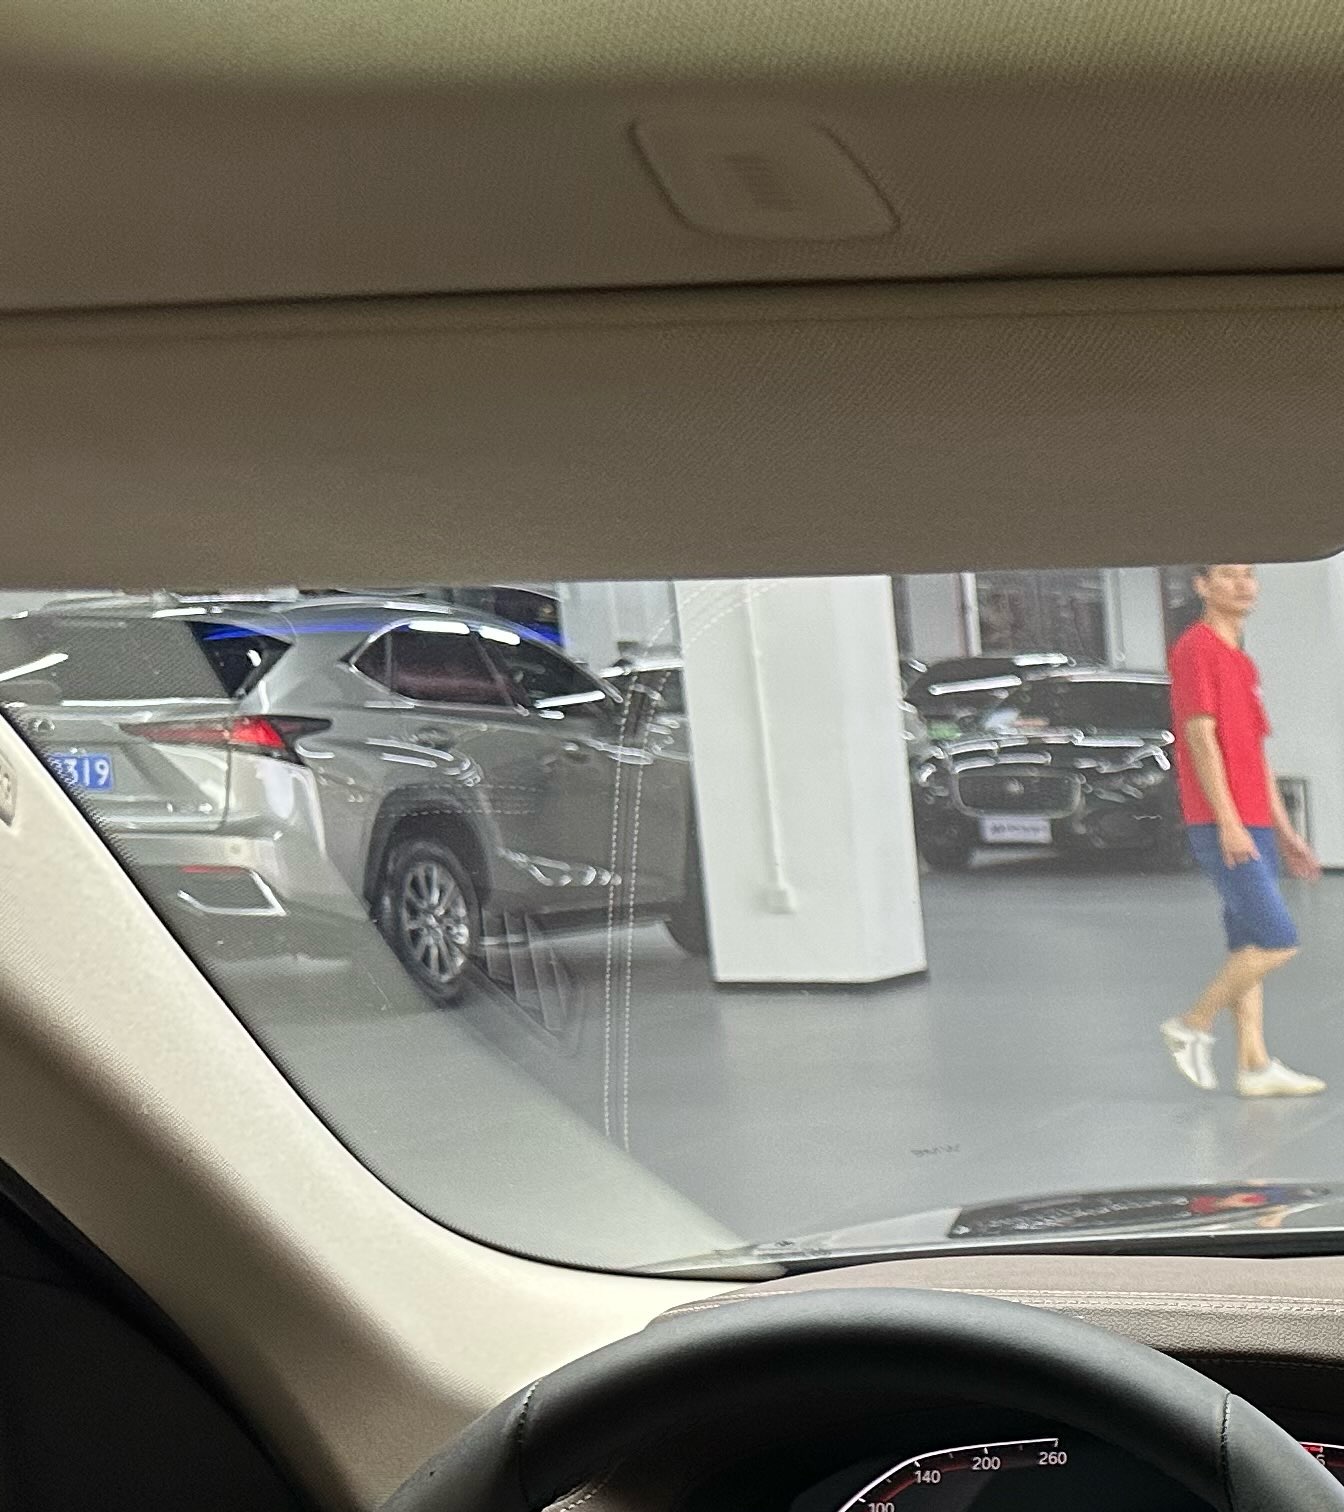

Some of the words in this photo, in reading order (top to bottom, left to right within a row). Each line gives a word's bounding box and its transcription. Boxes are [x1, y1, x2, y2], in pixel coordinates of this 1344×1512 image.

[971, 1456, 1001, 1471] 200
[1038, 1450, 1068, 1466] 260
[914, 1469, 941, 1485] 140
